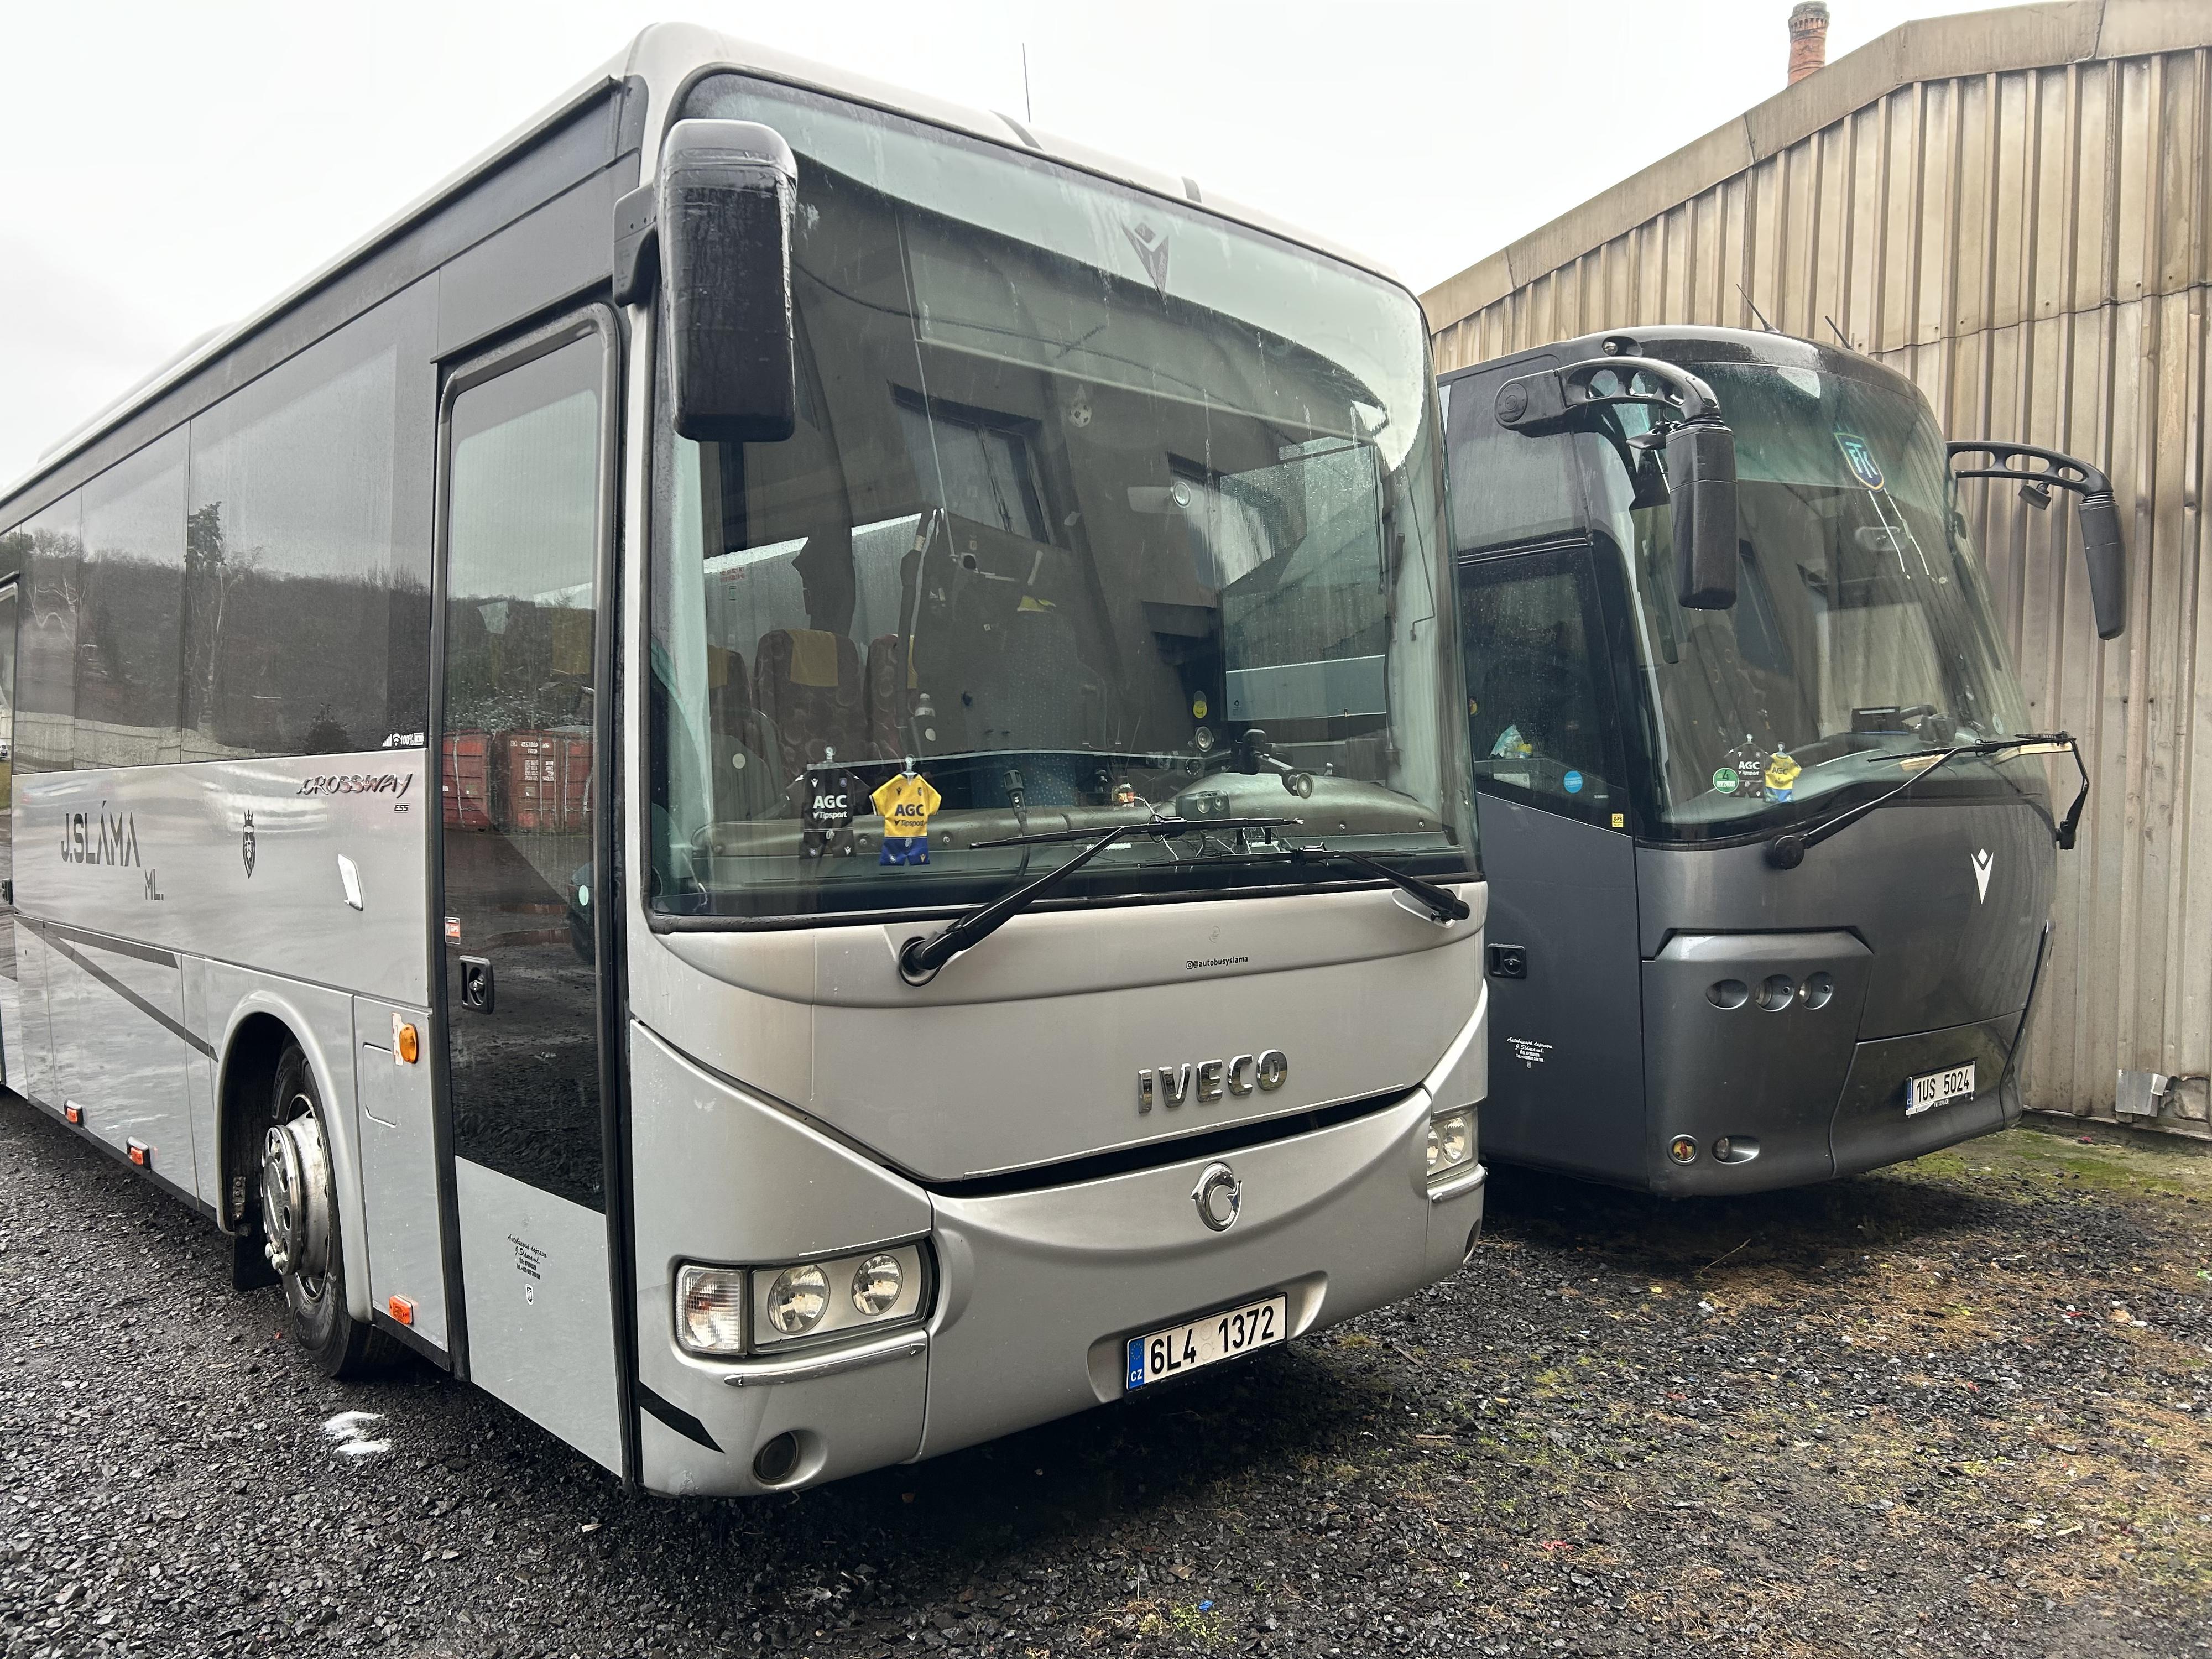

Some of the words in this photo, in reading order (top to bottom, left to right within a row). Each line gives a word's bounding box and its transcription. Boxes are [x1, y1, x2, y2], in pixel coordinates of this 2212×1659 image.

[400, 734, 414, 746] 100%
[1739, 761, 1760, 770] AGC
[1772, 766, 1788, 775] AGC
[1722, 769, 1730, 781] 4
[296, 773, 413, 799] CROSSWAY
[812, 795, 847, 809] AGC
[820, 811, 848, 820] Tipsport
[894, 804, 925, 817] AGC
[1138, 1050, 1288, 1114] IVECO
[1917, 1078, 1936, 1103] 1US
[1944, 1069, 1969, 1095] 5024
[1150, 1328, 1197, 1374] 6L4
[1218, 1305, 1274, 1353] 1372
[1131, 1369, 1142, 1382] CZ
